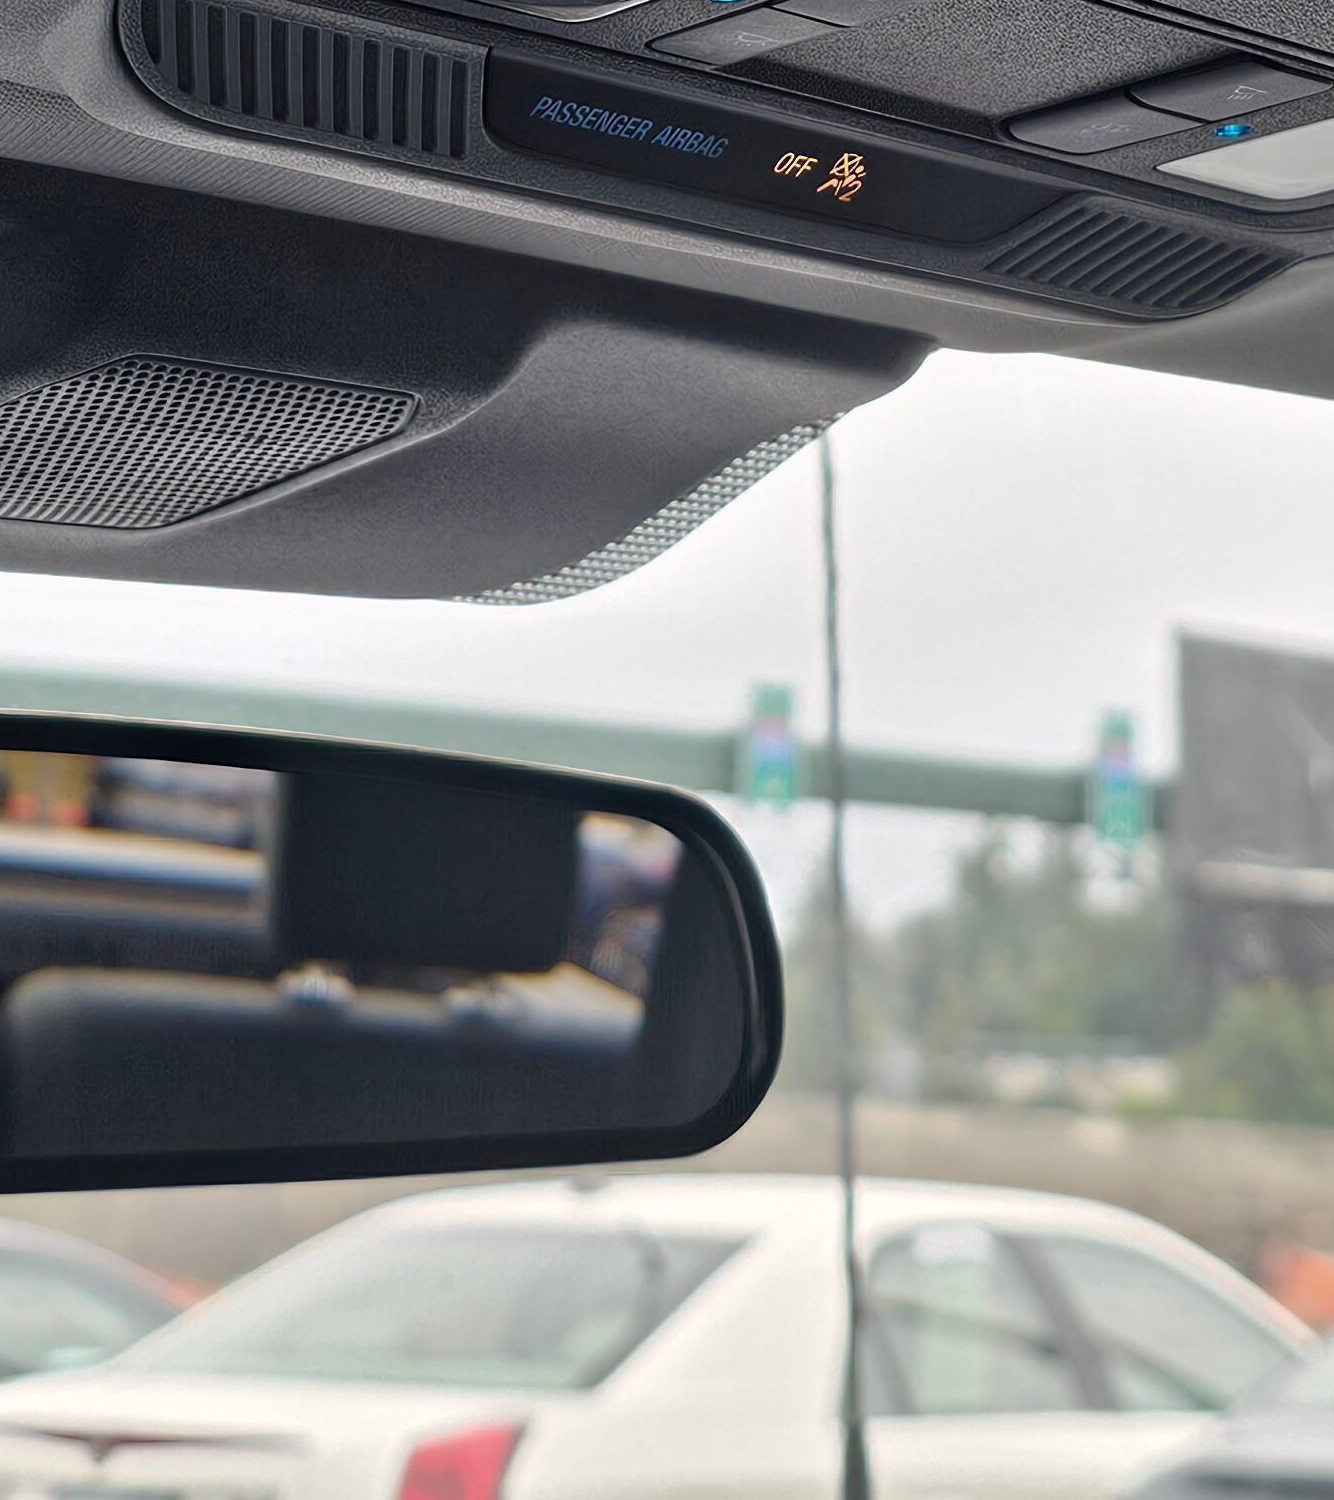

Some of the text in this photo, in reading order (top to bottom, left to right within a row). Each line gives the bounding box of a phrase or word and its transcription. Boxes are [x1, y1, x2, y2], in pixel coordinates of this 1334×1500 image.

[531, 96, 728, 158] PASSENGER AIRBAG
[773, 152, 817, 178] OFF
